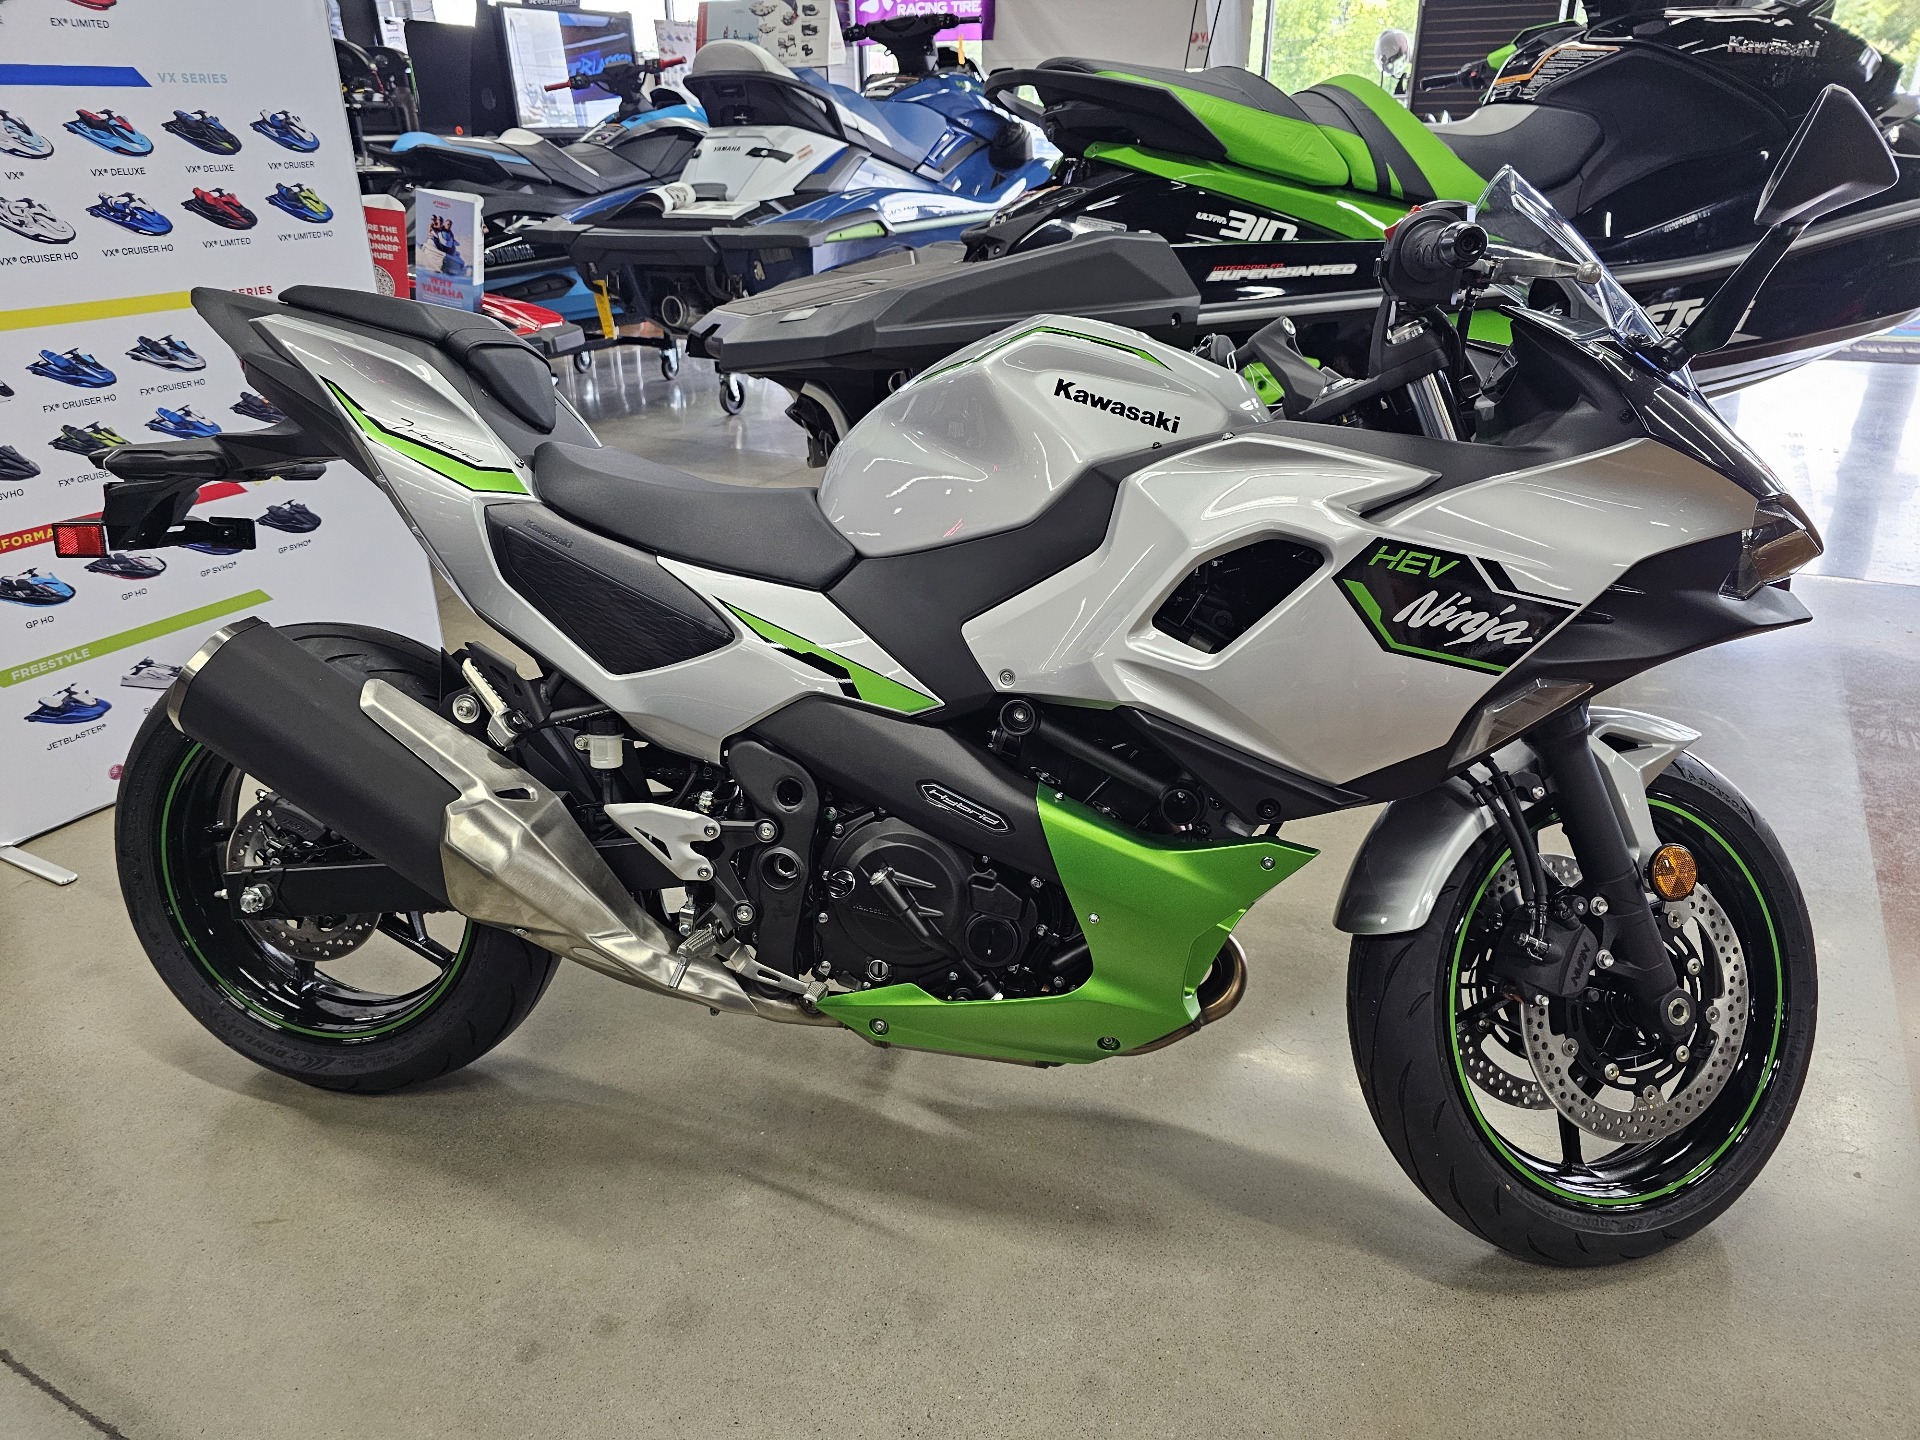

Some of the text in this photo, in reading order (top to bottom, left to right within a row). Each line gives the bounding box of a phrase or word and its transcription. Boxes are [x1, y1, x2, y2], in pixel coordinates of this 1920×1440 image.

[951, 1, 983, 13] TIRE
[70, 19, 110, 29] LIMITED
[1727, 35, 1820, 57] Kawasaki
[157, 72, 228, 84] VX SERIES
[110, 167, 147, 176] DELUXE
[203, 164, 235, 173] DELUXE
[283, 161, 315, 170] CRUISER
[380, 225, 398, 233] THE
[1196, 210, 1300, 242] ULTRA 310
[293, 231, 322, 241] LIMITED
[323, 230, 333, 238] HO
[219, 238, 251, 247] LIMITED
[121, 245, 160, 255] CRUISER
[161, 244, 174, 252] HO
[19, 253, 63, 265] CRUISER
[64, 252, 79, 260] HO
[1205, 263, 1358, 282] SUPERCHARGED
[1212, 262, 1285, 272] INTERCOOLED
[422, 283, 464, 299] YAMAHA
[157, 381, 193, 393] CRUISER
[194, 378, 206, 387] HO
[62, 397, 102, 410] CRUISER
[103, 394, 117, 403] HO
[1053, 377, 1181, 434] Kawasaki
[77, 470, 113, 484] CRUISE
[524, 519, 574, 550] Kawasaki
[278, 546, 289, 555] GP
[1368, 545, 1460, 579] HEV
[200, 568, 212, 577] GP
[121, 588, 148, 601] GP HO
[26, 615, 55, 629] GP HO
[1392, 590, 1533, 647] Ninja
[11, 648, 91, 681] FREESTYLE
[929, 788, 1000, 826] Hybrid
